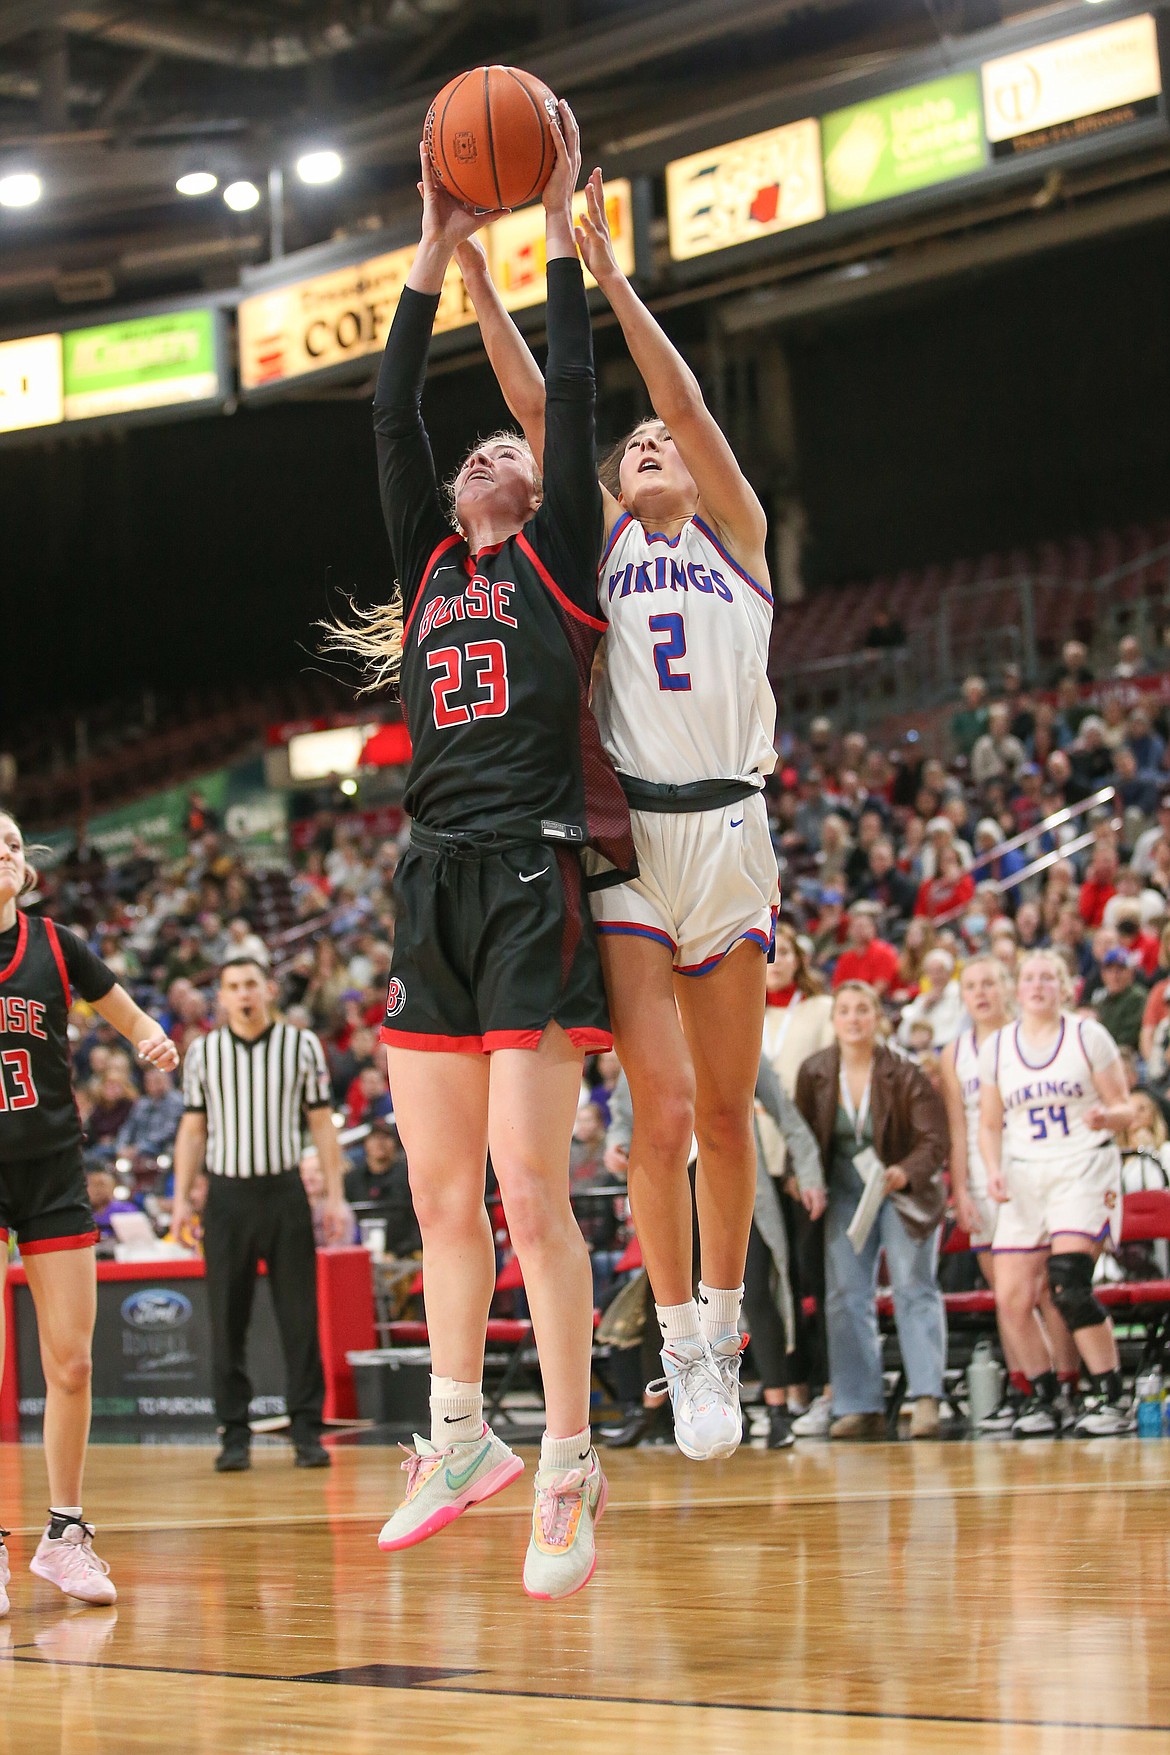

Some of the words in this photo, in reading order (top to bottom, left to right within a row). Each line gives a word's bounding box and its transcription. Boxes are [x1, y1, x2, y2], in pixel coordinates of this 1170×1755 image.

[417, 575, 518, 648] BOISE
[608, 557, 734, 604] VIKINGS
[427, 639, 509, 730] 23
[649, 612, 692, 691] 2
[1029, 1105, 1070, 1140] 54
